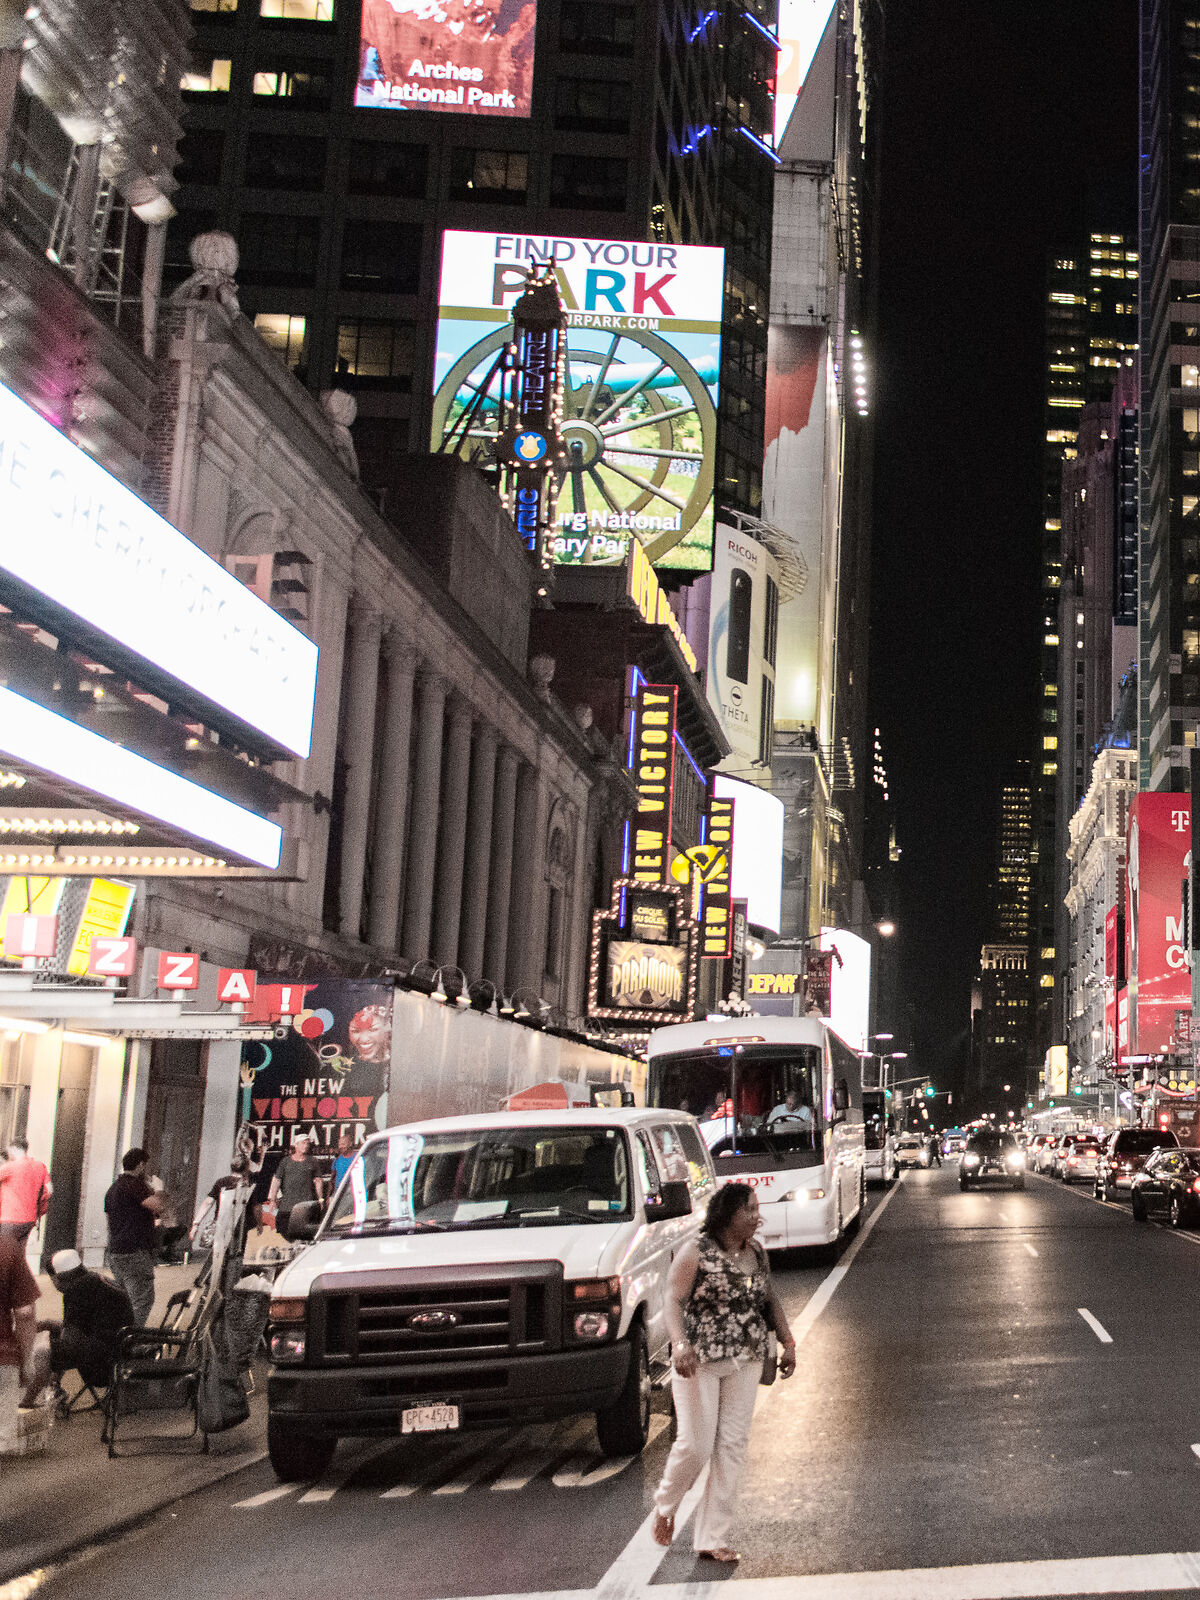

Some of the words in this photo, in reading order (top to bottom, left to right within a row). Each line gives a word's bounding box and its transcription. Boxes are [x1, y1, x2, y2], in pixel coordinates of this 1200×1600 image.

[408, 59, 484, 82] Arches
[373, 80, 464, 105] National
[467, 87, 516, 109] Park
[494, 236, 576, 262] FIND
[583, 241, 678, 269] YOUR
[524, 332, 547, 415] THEATRE
[517, 488, 539, 550] LYRIC
[592, 511, 682, 531] National
[593, 535, 628, 552] Par
[728, 540, 758, 564] RICOH
[722, 704, 749, 724] THETA
[638, 692, 670, 812] VICTORY
[707, 801, 732, 895] VIORY
[636, 906, 663, 916] CIRQUE
[704, 906, 728, 953] NEW
[731, 912, 746, 995] KECHERS
[611, 956, 683, 1003] PARAMOUR
[280, 1084, 299, 1096] THE
[304, 1078, 345, 1095] NEW
[253, 1096, 374, 1120] VICTORY
